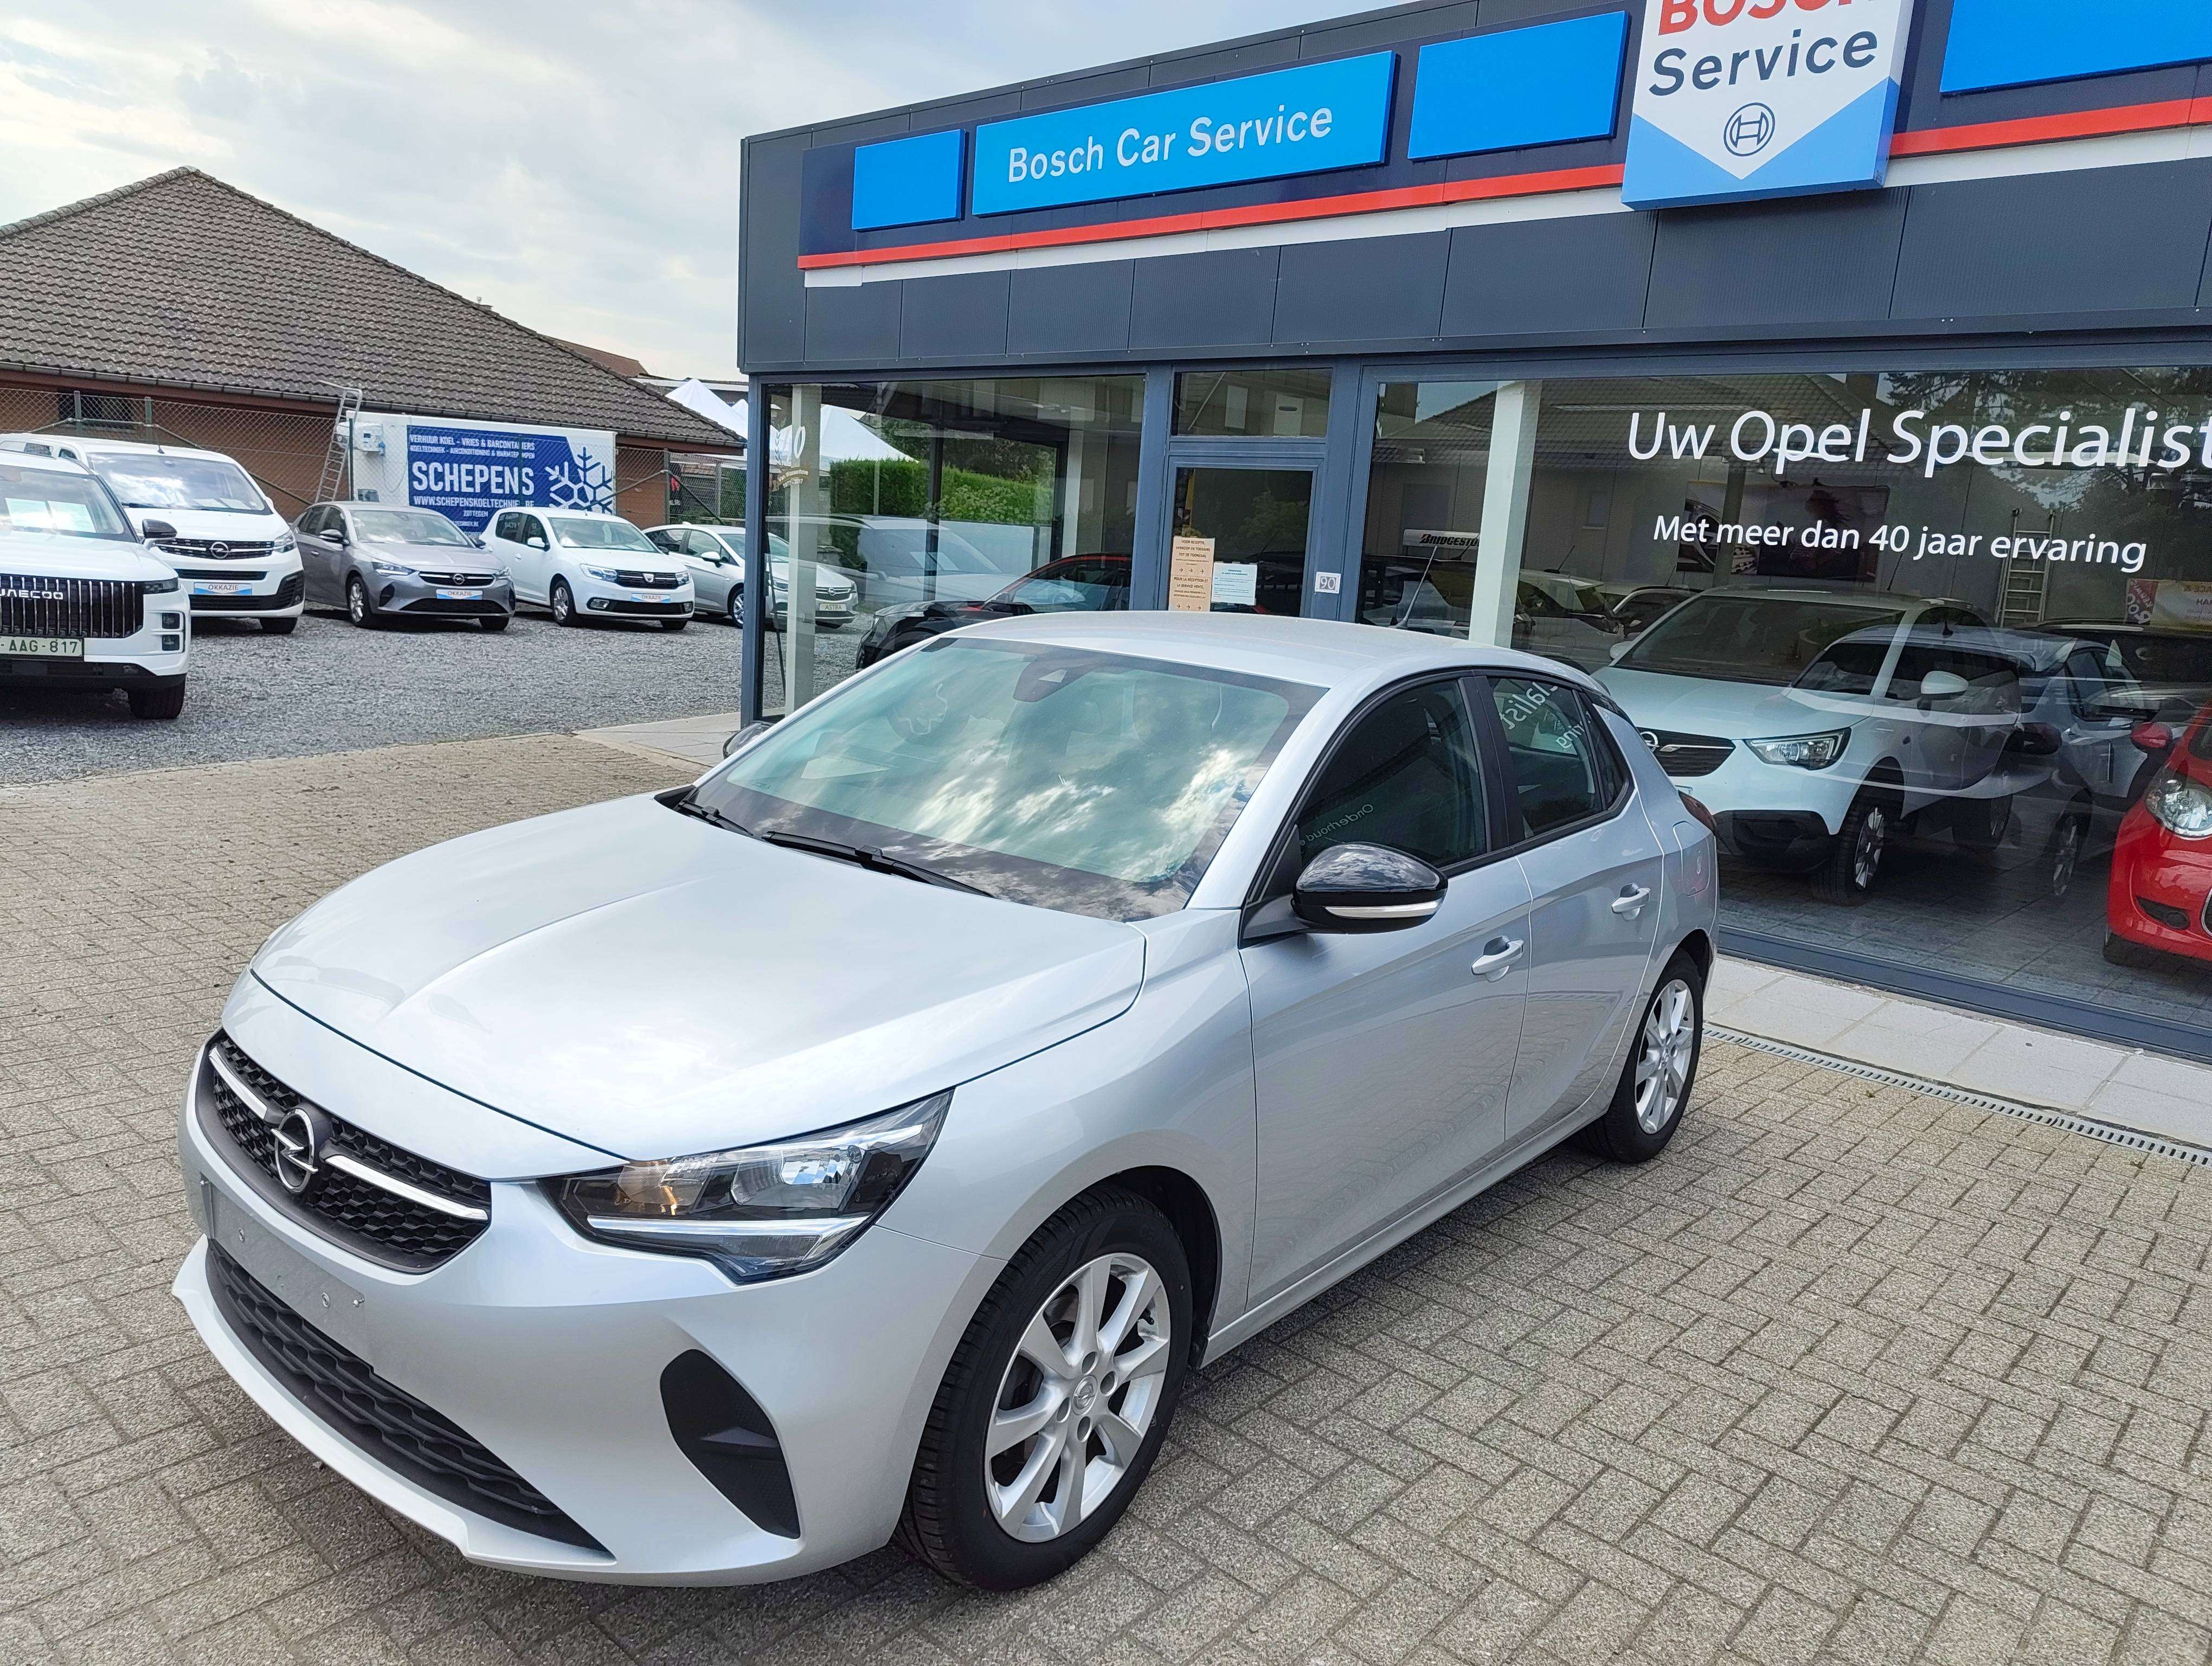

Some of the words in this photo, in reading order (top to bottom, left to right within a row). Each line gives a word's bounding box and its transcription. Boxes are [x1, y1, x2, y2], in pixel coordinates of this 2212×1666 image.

[1649, 29, 1877, 97] Service
[1008, 135, 1104, 183] Bosch
[1117, 128, 1176, 167] Car
[1187, 105, 1333, 157] Service
[409, 434, 438, 444] VERHUUR
[440, 436, 455, 445] KOEL
[461, 438, 479, 447] VRIES
[480, 438, 486, 447] &
[497, 450, 535, 459] WARMTEPMPEN
[1629, 412, 1715, 459] Uw
[1731, 408, 1871, 475] Opel
[413, 461, 534, 496] SCHEPENS
[1419, 534, 1480, 547] BRIDGESTO
[1653, 515, 1709, 543] Met
[1716, 523, 1794, 546] meer
[1801, 520, 1859, 549] dan
[1868, 524, 1909, 552] 40
[1913, 526, 1982, 560] jaar
[1990, 533, 2147, 573] ervaring
[1320, 576, 1335, 589] 90
